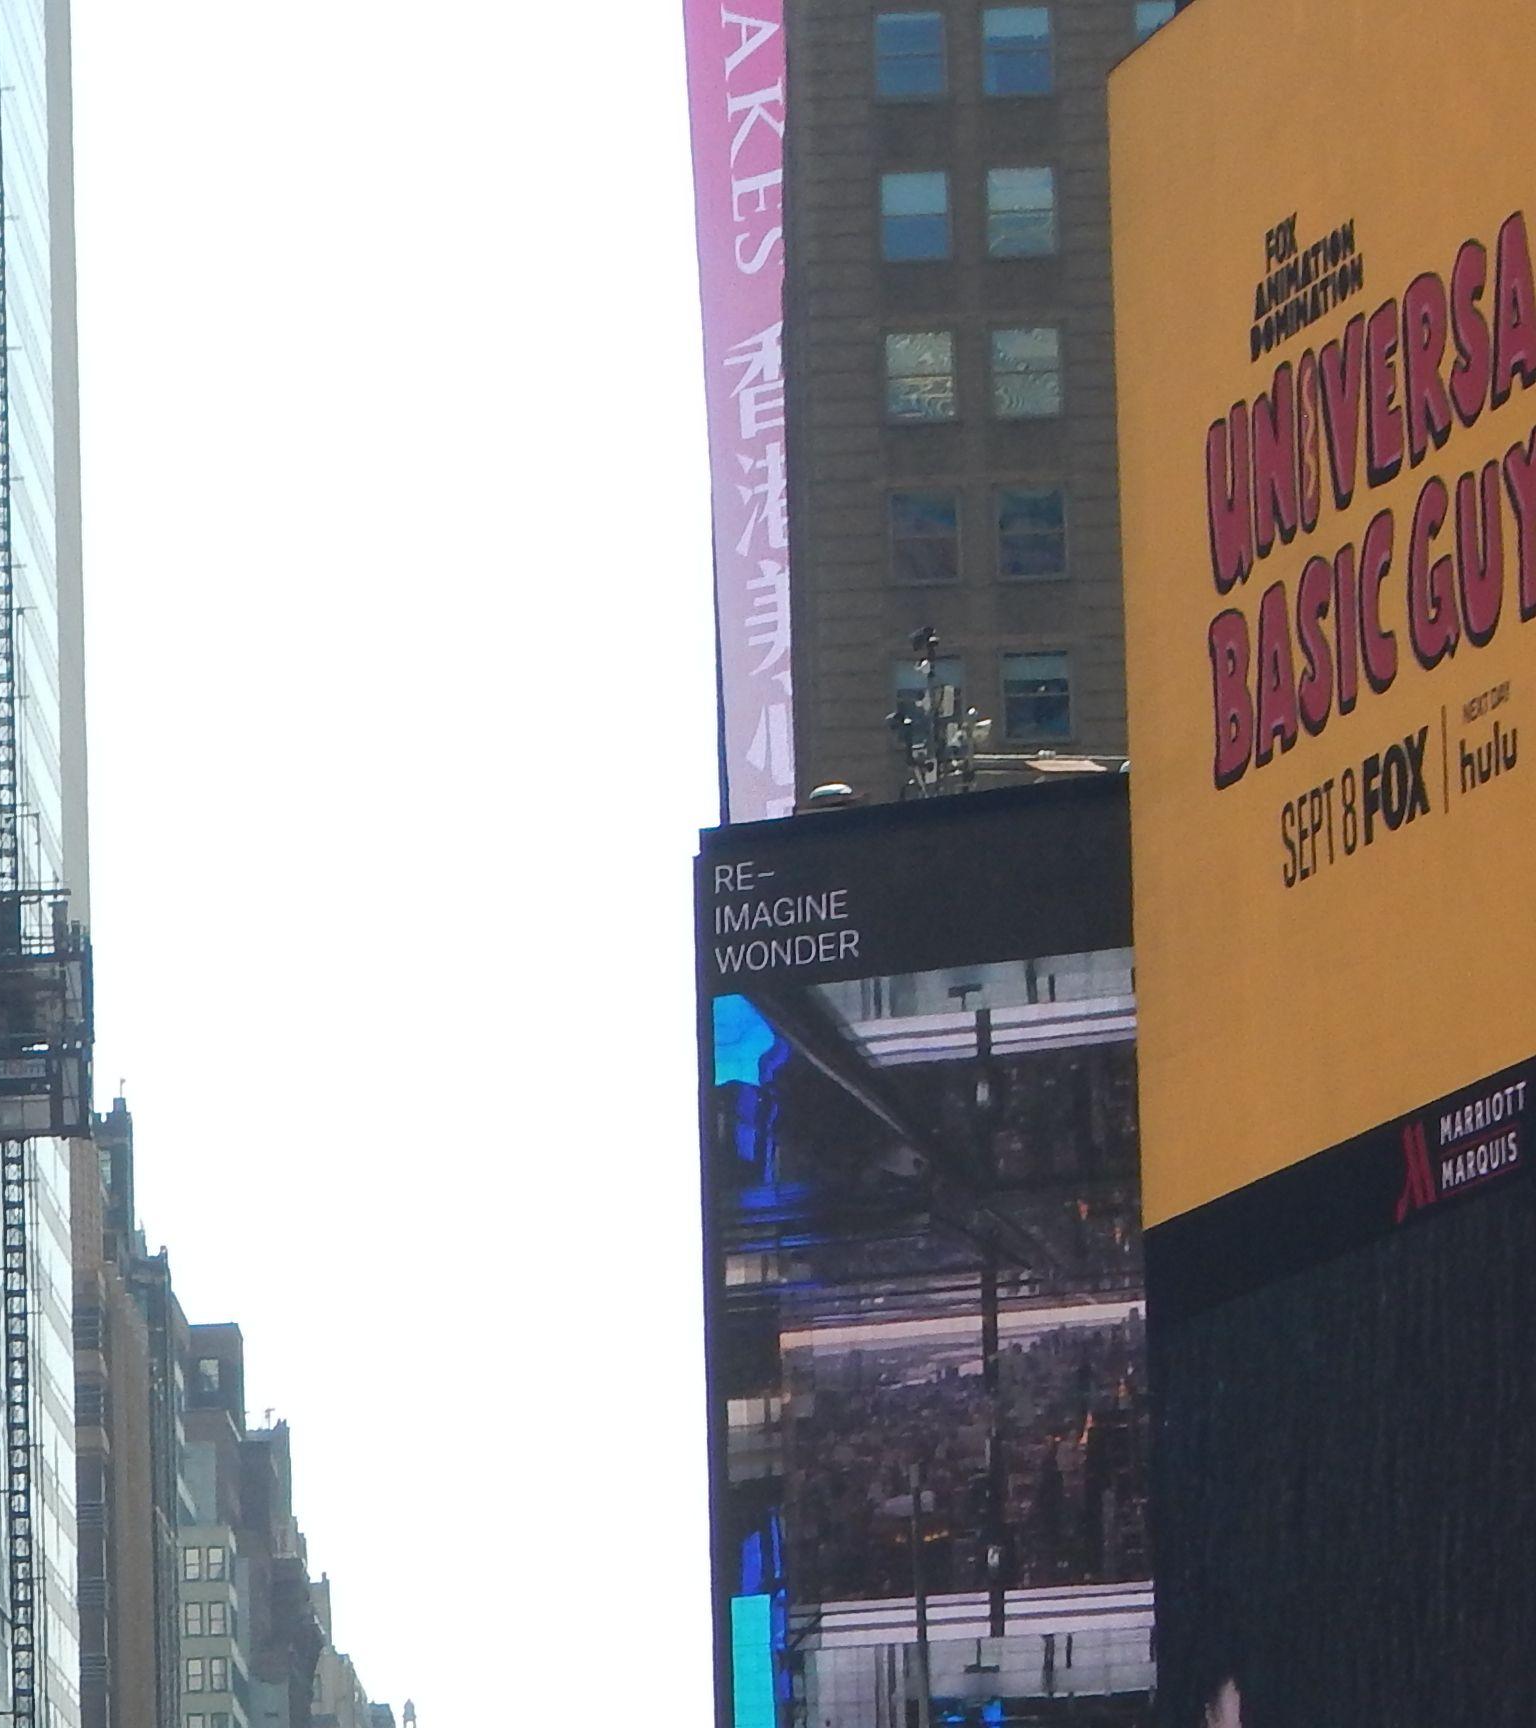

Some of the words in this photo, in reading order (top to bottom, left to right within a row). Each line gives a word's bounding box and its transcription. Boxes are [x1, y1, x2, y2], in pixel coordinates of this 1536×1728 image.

[1209, 506, 1399, 791] BASIC
[1281, 777, 1335, 889] SEPT
[1341, 768, 1358, 856] 8
[1362, 724, 1432, 847] FOX
[1460, 720, 1518, 795] hulu
[715, 889, 849, 935] IMAGINE
[714, 929, 860, 974] WONDER
[1440, 1080, 1528, 1146] MARRIOTT
[1441, 1131, 1519, 1190] MARQUIS
